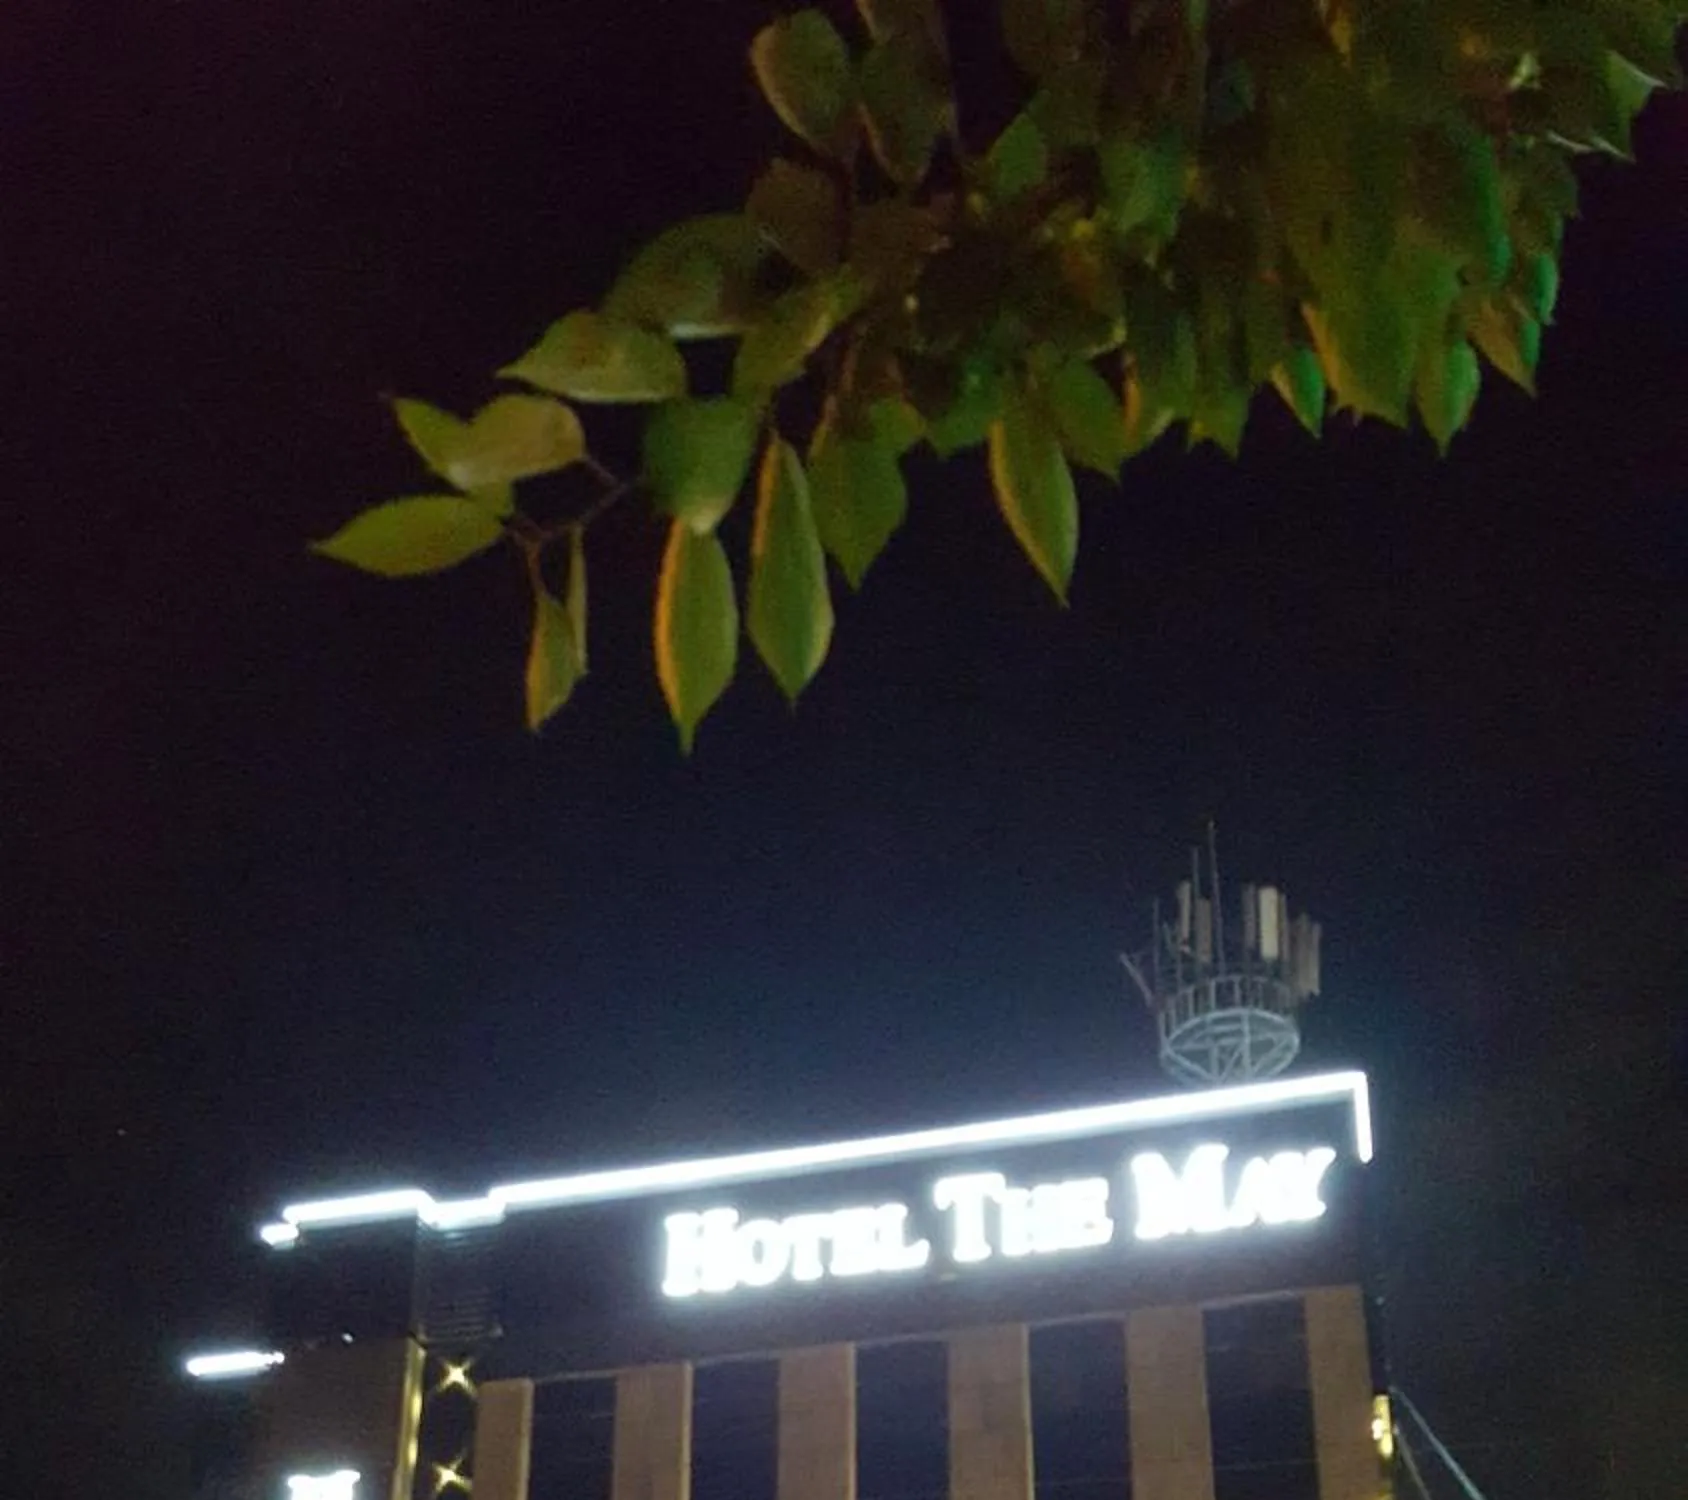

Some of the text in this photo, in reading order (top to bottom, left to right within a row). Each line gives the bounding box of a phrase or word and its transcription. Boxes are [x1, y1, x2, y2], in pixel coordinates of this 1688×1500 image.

[662, 1142, 1336, 1297] HOTEL THE MAY
